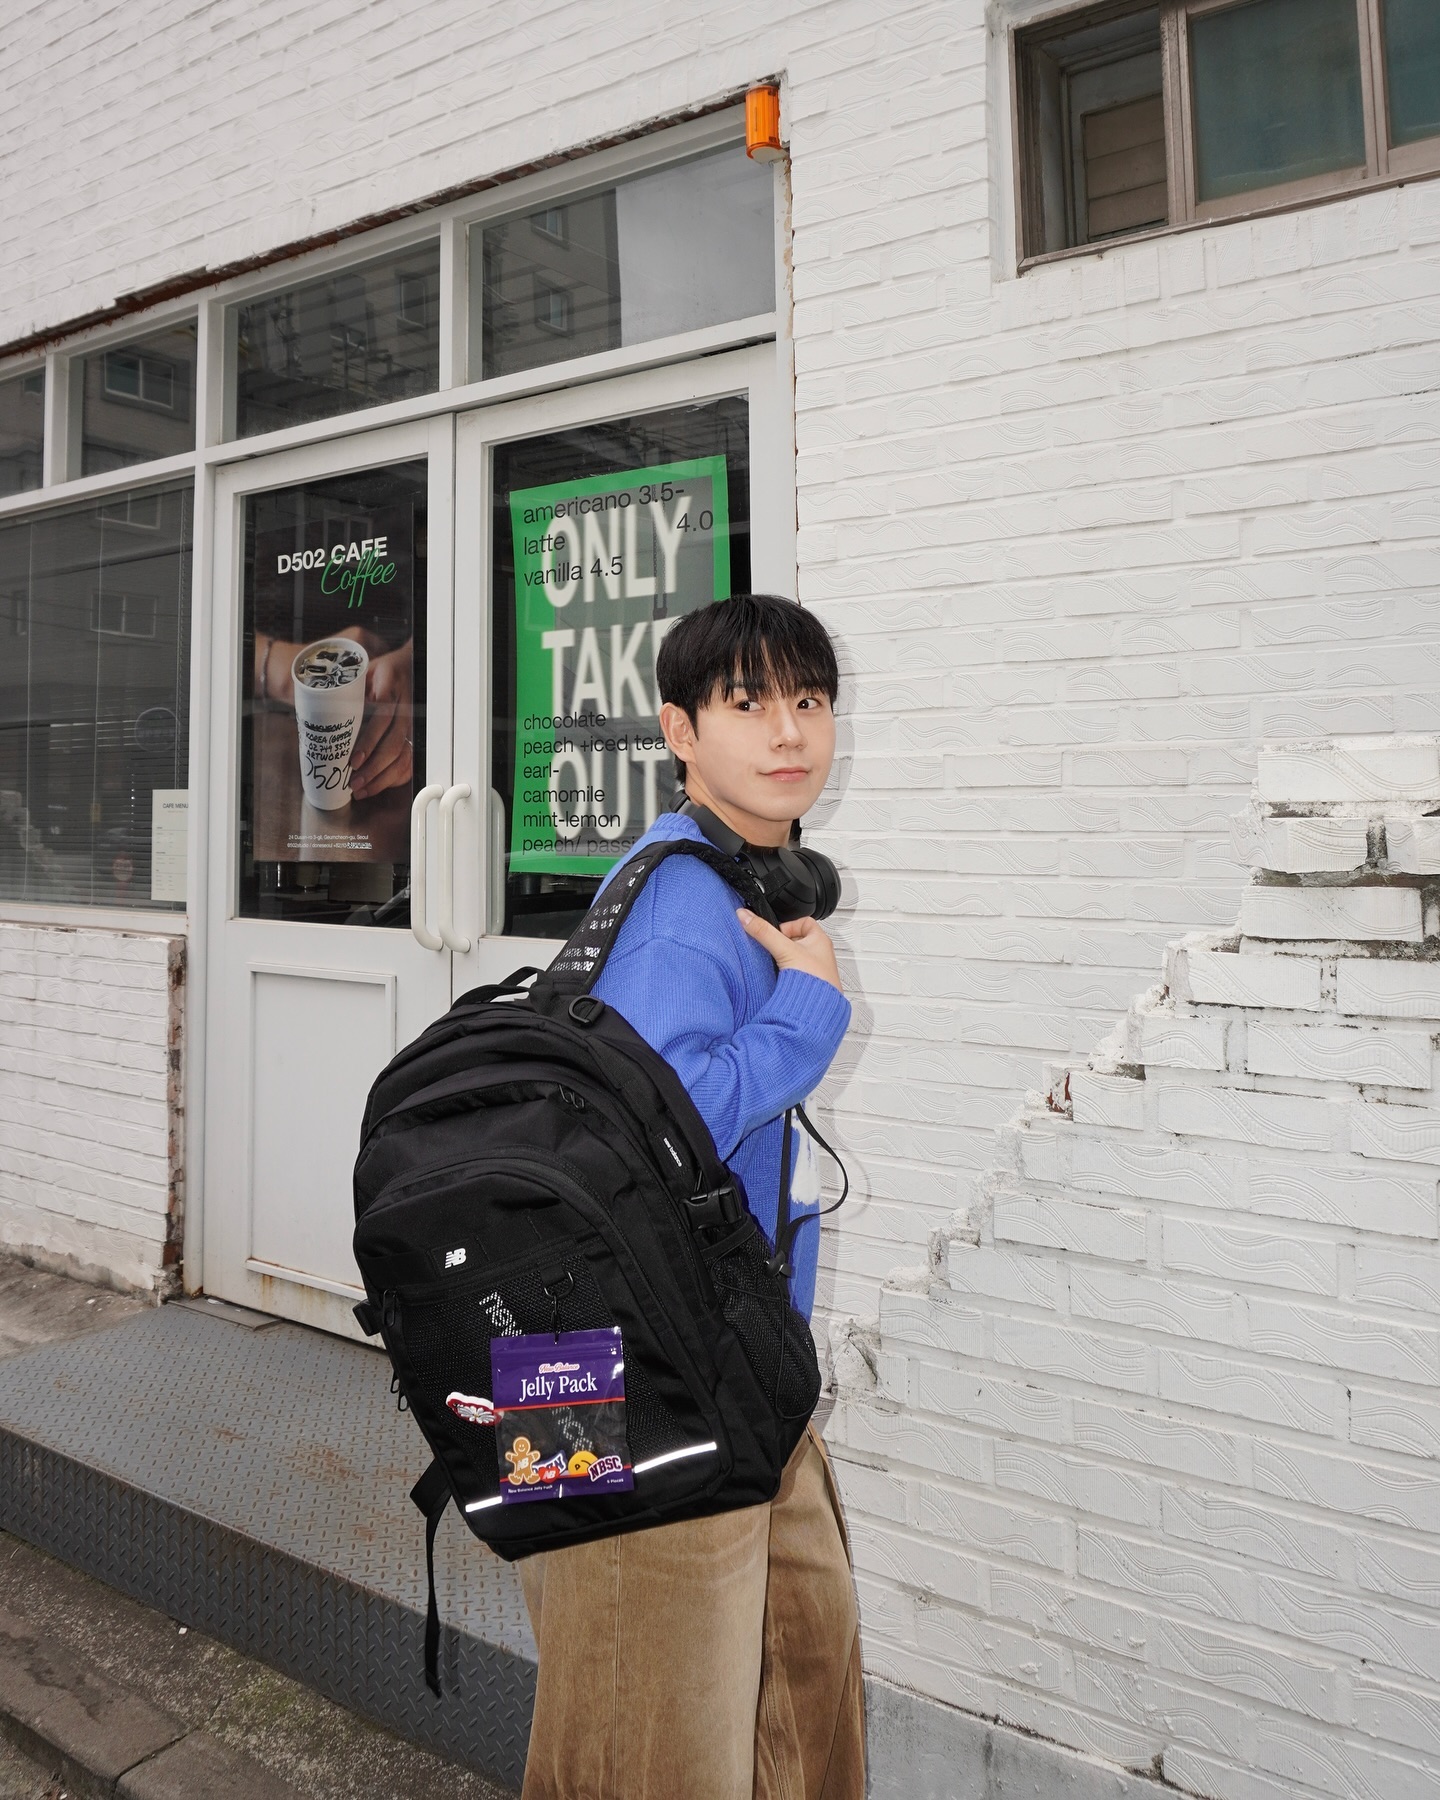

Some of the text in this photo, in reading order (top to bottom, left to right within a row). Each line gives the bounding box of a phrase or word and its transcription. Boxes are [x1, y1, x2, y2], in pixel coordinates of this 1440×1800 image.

[524, 481, 685, 524] americano 3.5-
[676, 510, 714, 533] 4.0
[277, 536, 388, 574] D502 CAFE
[524, 533, 566, 555] latte
[541, 495, 692, 607] ONLY
[321, 548, 397, 608] Coffee
[524, 555, 623, 586] vanilla 4.5
[523, 711, 607, 730] chocolate
[307, 748, 350, 761] ARTWORKS
[523, 734, 667, 758] peach +iced tea
[523, 762, 560, 778] earl-
[523, 785, 605, 803] camomile
[548, 742, 671, 840] OUT
[523, 811, 621, 828] mint-lemon
[523, 836, 581, 855] peach/
[519, 1371, 598, 1402] Jelly Pack
[589, 1456, 622, 1481] NBSC
